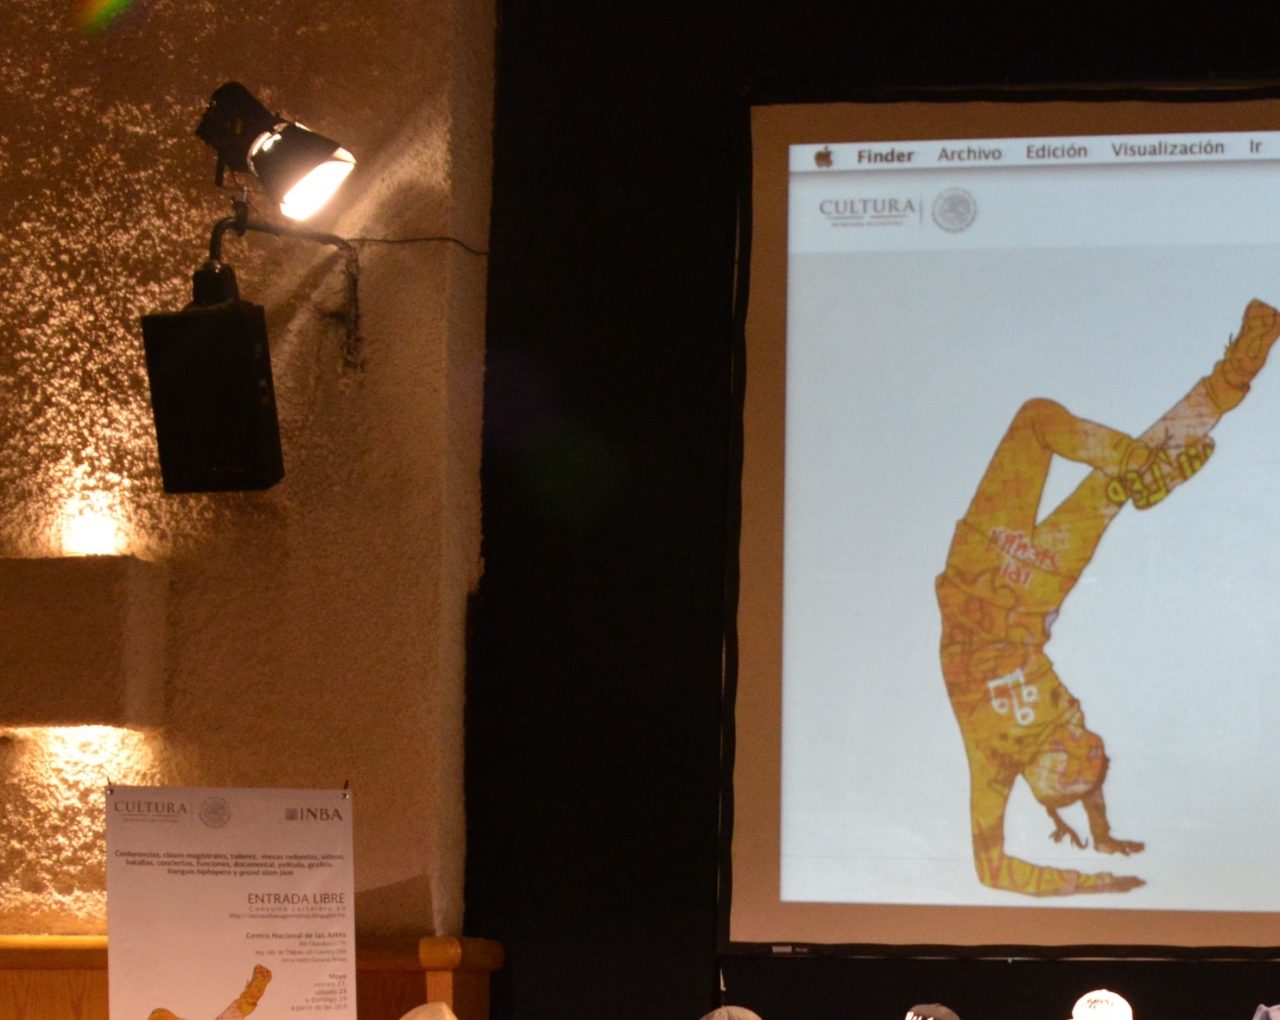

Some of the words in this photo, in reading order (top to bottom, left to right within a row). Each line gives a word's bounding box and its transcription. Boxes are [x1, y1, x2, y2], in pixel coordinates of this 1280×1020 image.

[857, 149, 915, 165] Finder
[938, 144, 1003, 162] Archivo
[1026, 142, 1088, 160] Edición
[1112, 140, 1226, 158] Visualización
[1250, 139, 1262, 153] Ir
[819, 198, 915, 215] CULTURA
[114, 801, 187, 815] CULTURA
[299, 808, 343, 821] INBA
[247, 893, 309, 905] ENTRADA
[313, 893, 345, 904] LIBRE
